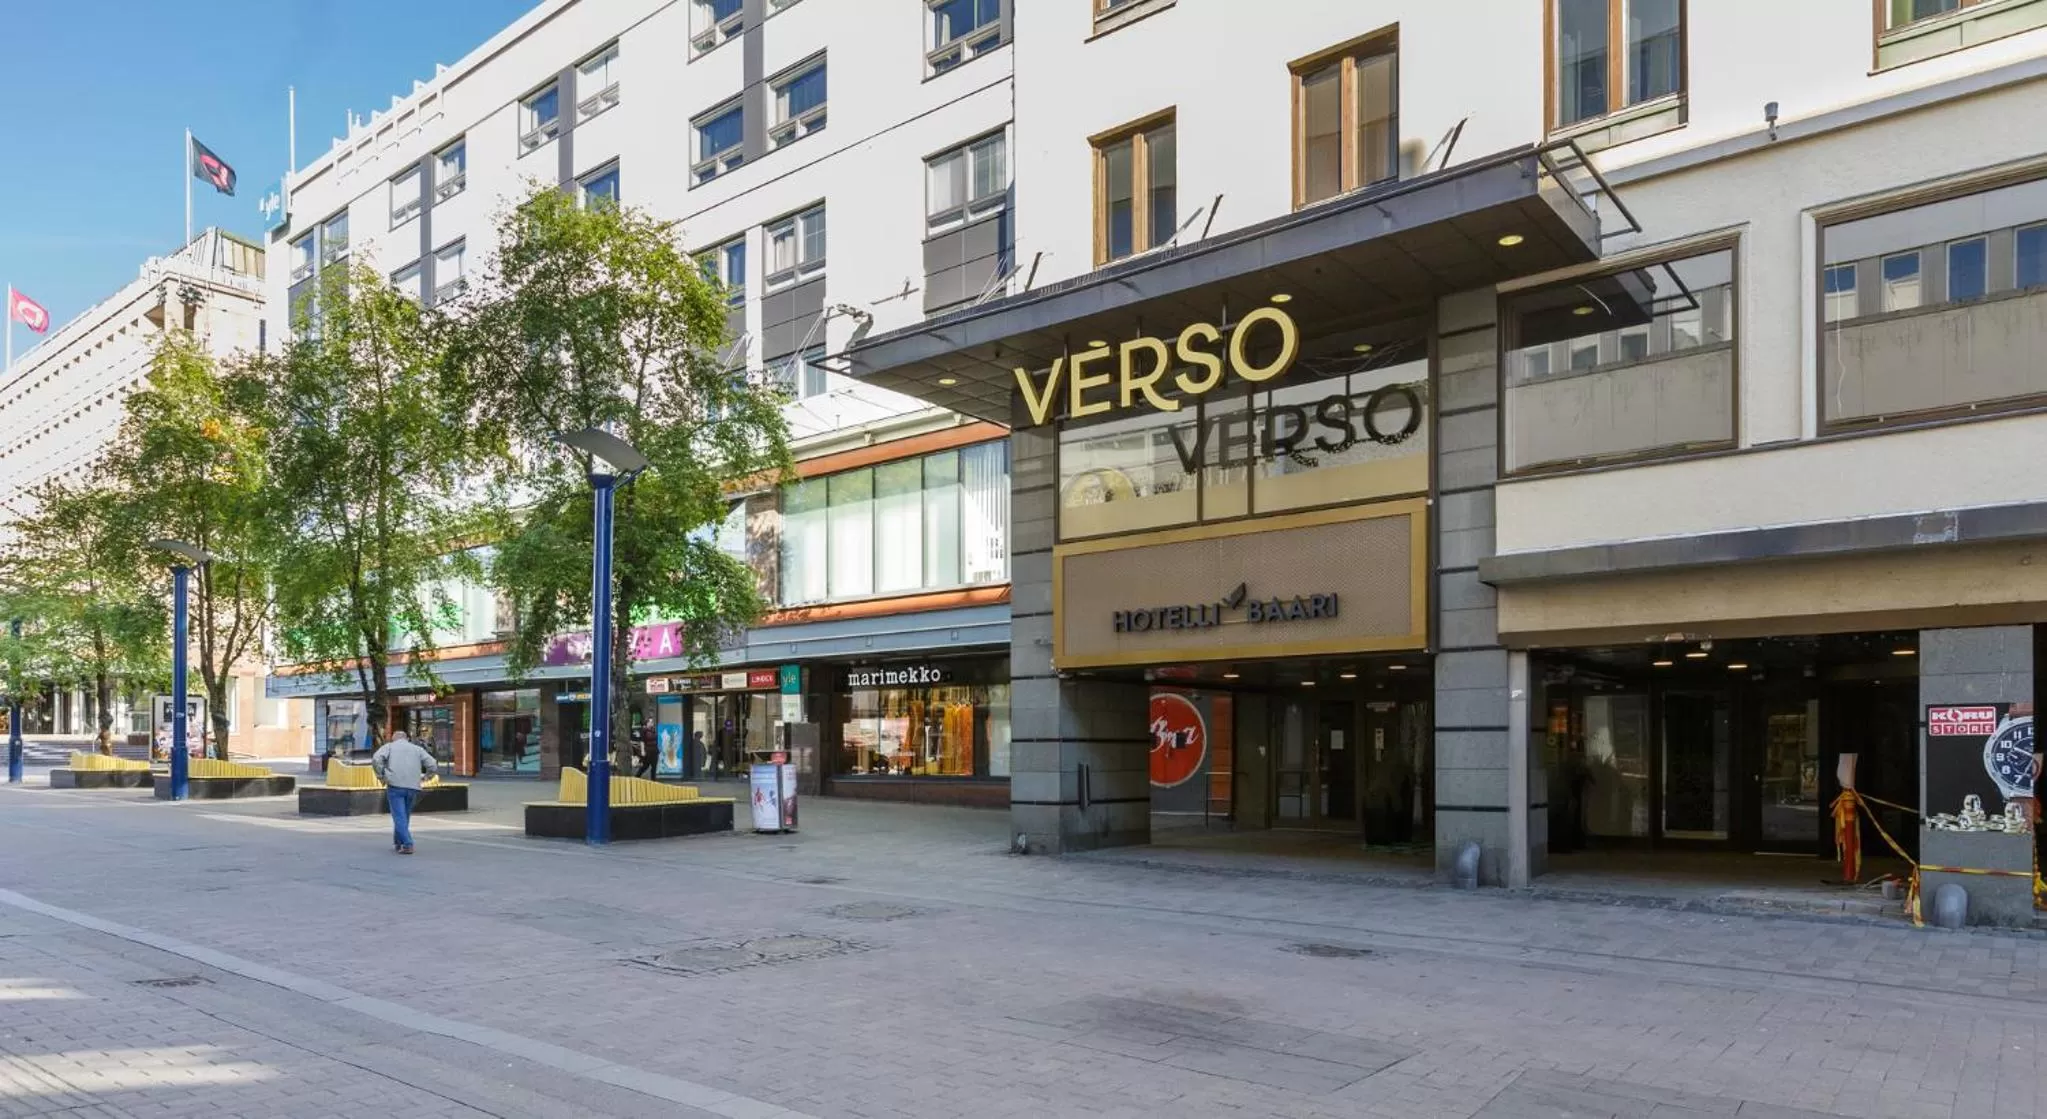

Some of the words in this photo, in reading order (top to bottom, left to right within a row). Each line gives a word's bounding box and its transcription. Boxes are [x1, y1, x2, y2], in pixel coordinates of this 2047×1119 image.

[1013, 306, 1298, 427] VERSO
[1167, 383, 1423, 475] VERSO
[1113, 603, 1220, 633] HOTELLI
[1248, 592, 1338, 623] BAARI
[782, 671, 797, 687] yle
[847, 666, 941, 686] marimekko
[1931, 709, 1993, 722] KORU
[1932, 725, 1994, 734] STORE
[2013, 731, 2022, 740] 11
[2000, 740, 2012, 748] 10
[1996, 753, 2004, 761] 9
